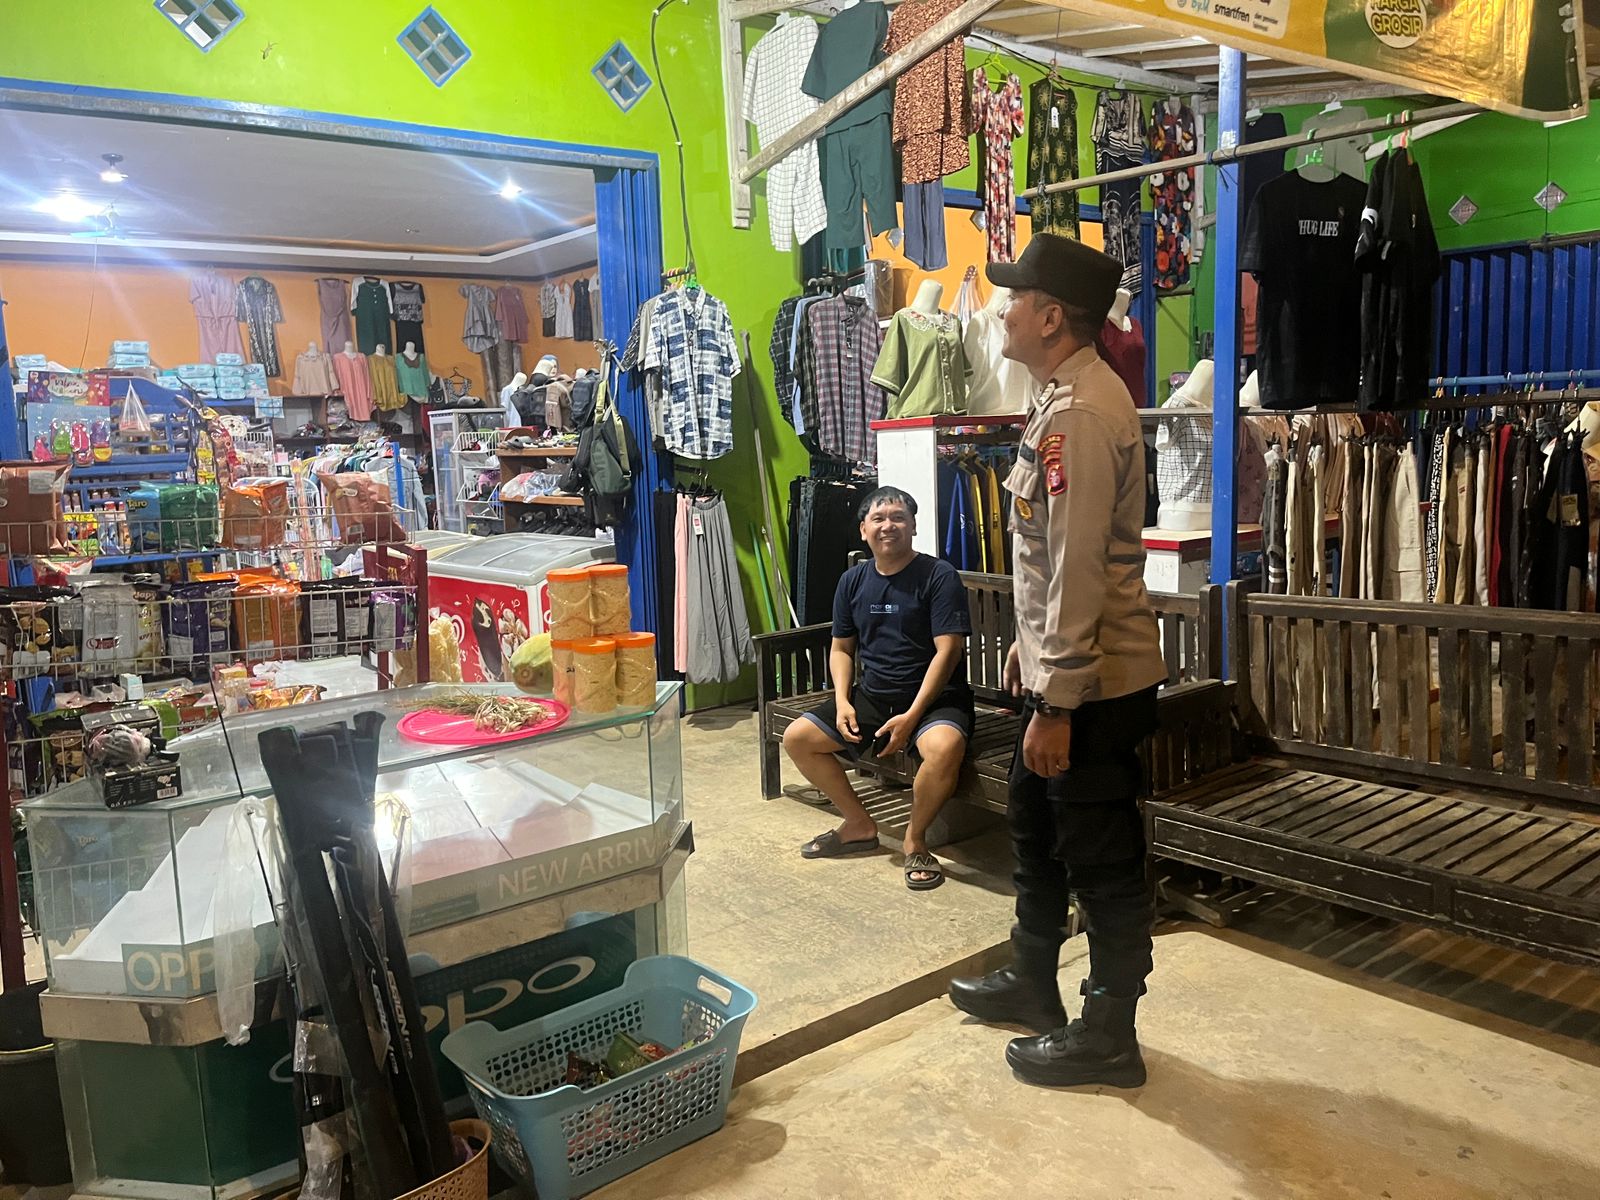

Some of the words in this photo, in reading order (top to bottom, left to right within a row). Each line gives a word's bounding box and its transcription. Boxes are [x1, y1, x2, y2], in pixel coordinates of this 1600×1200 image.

[1213, 4, 1250, 22] smartfren
[1371, 12, 1424, 37] GROSIR
[1298, 219, 1318, 235] HUG
[1319, 220, 1339, 236] LIFE
[126, 499, 148, 509] Taro
[498, 857, 569, 900] NEW
[127, 945, 260, 993] OPP
